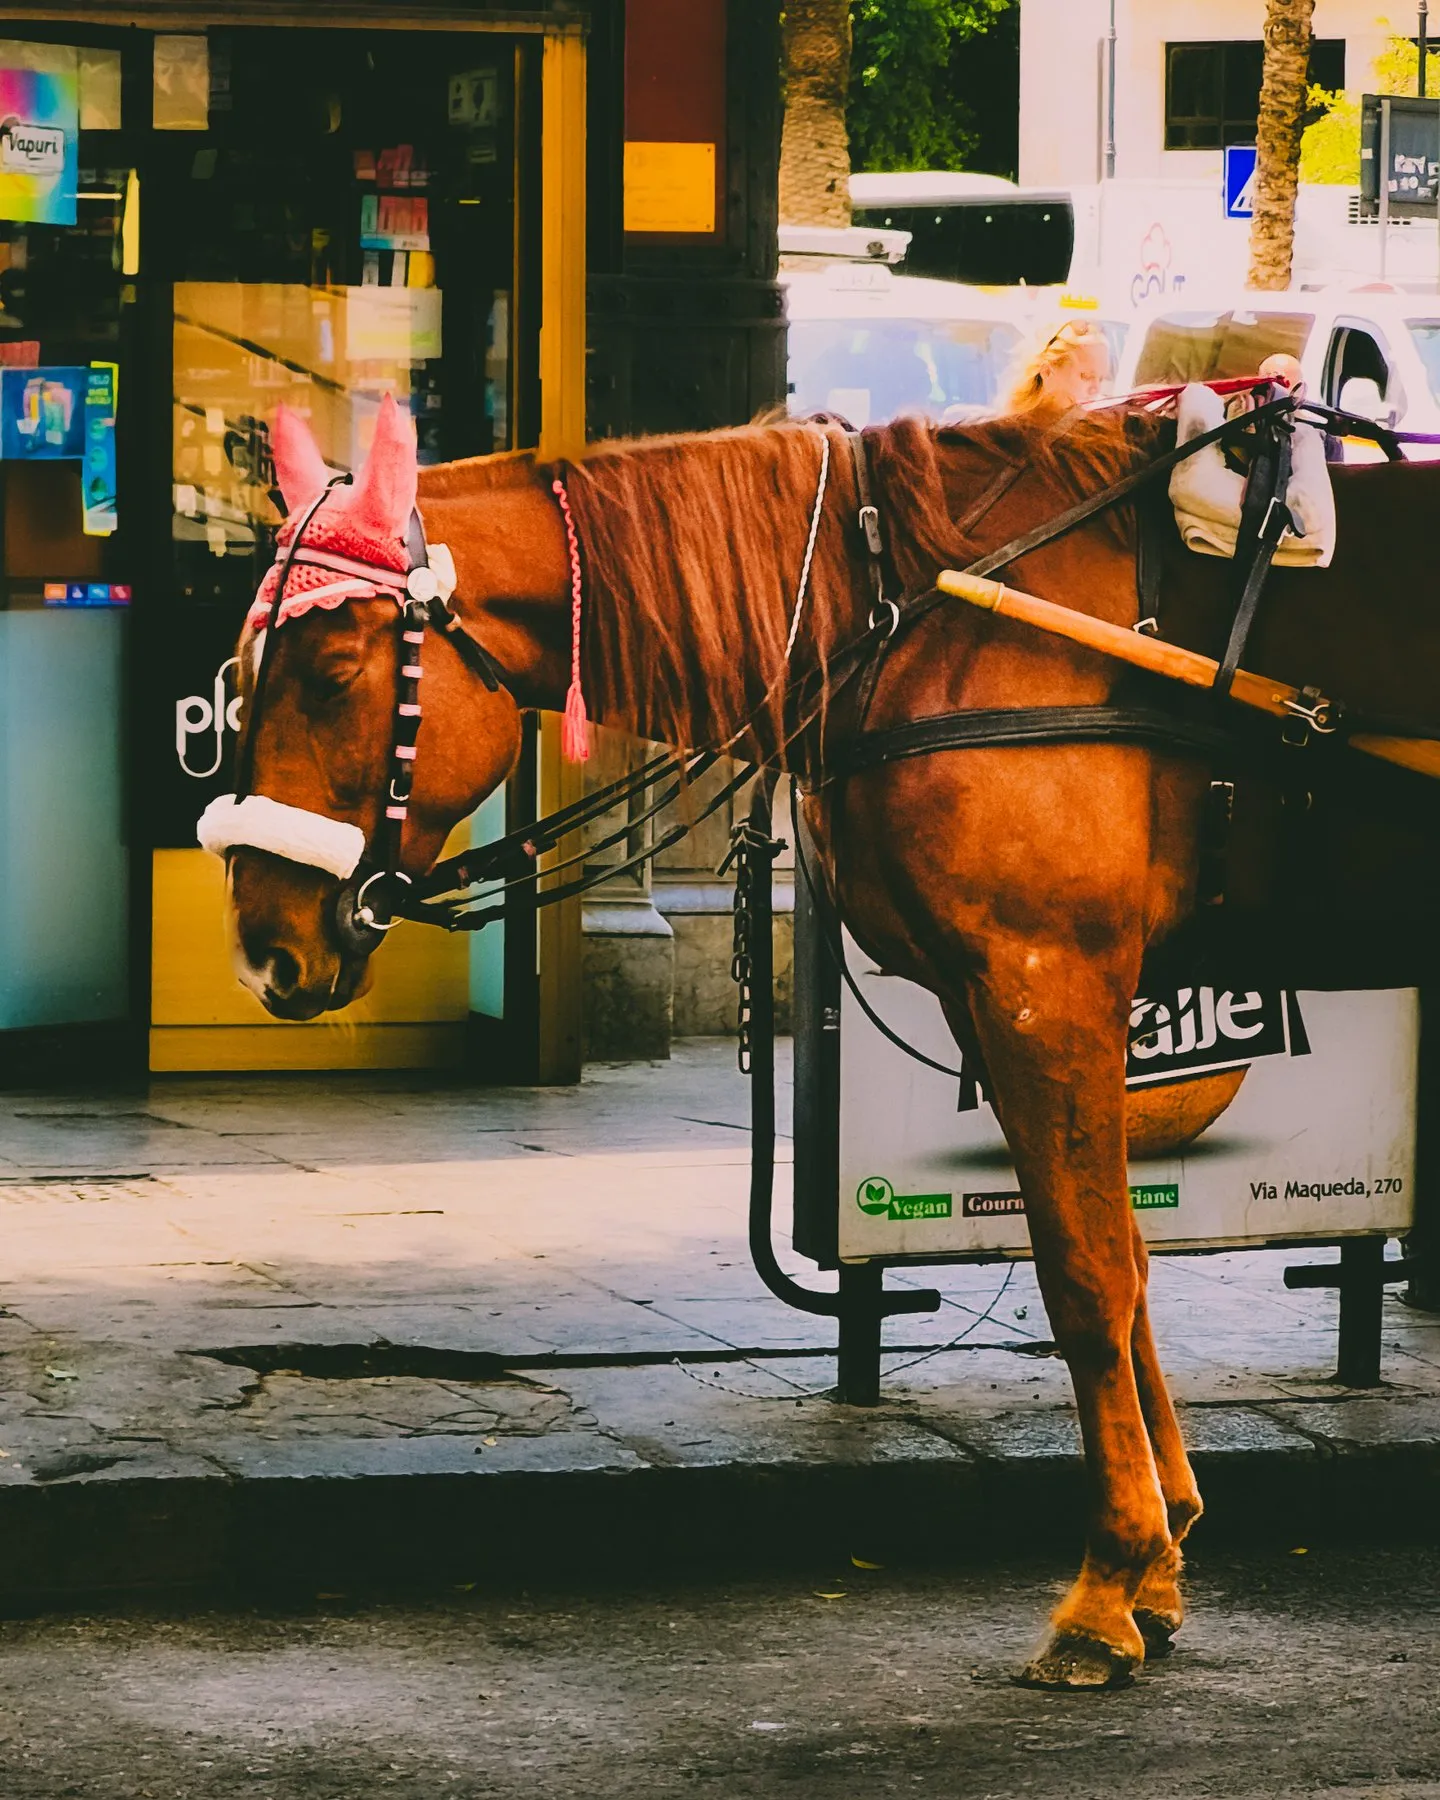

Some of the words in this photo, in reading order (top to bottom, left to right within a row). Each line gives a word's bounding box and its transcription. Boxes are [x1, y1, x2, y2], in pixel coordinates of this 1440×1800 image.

[8, 132, 58, 160] Vapuri
[1129, 1188, 1176, 1206] riane
[1249, 1181, 1278, 1200] Via
[1284, 1177, 1371, 1202] Maqueda,
[1374, 1177, 1403, 1195] 270
[892, 1199, 949, 1219] Vegan
